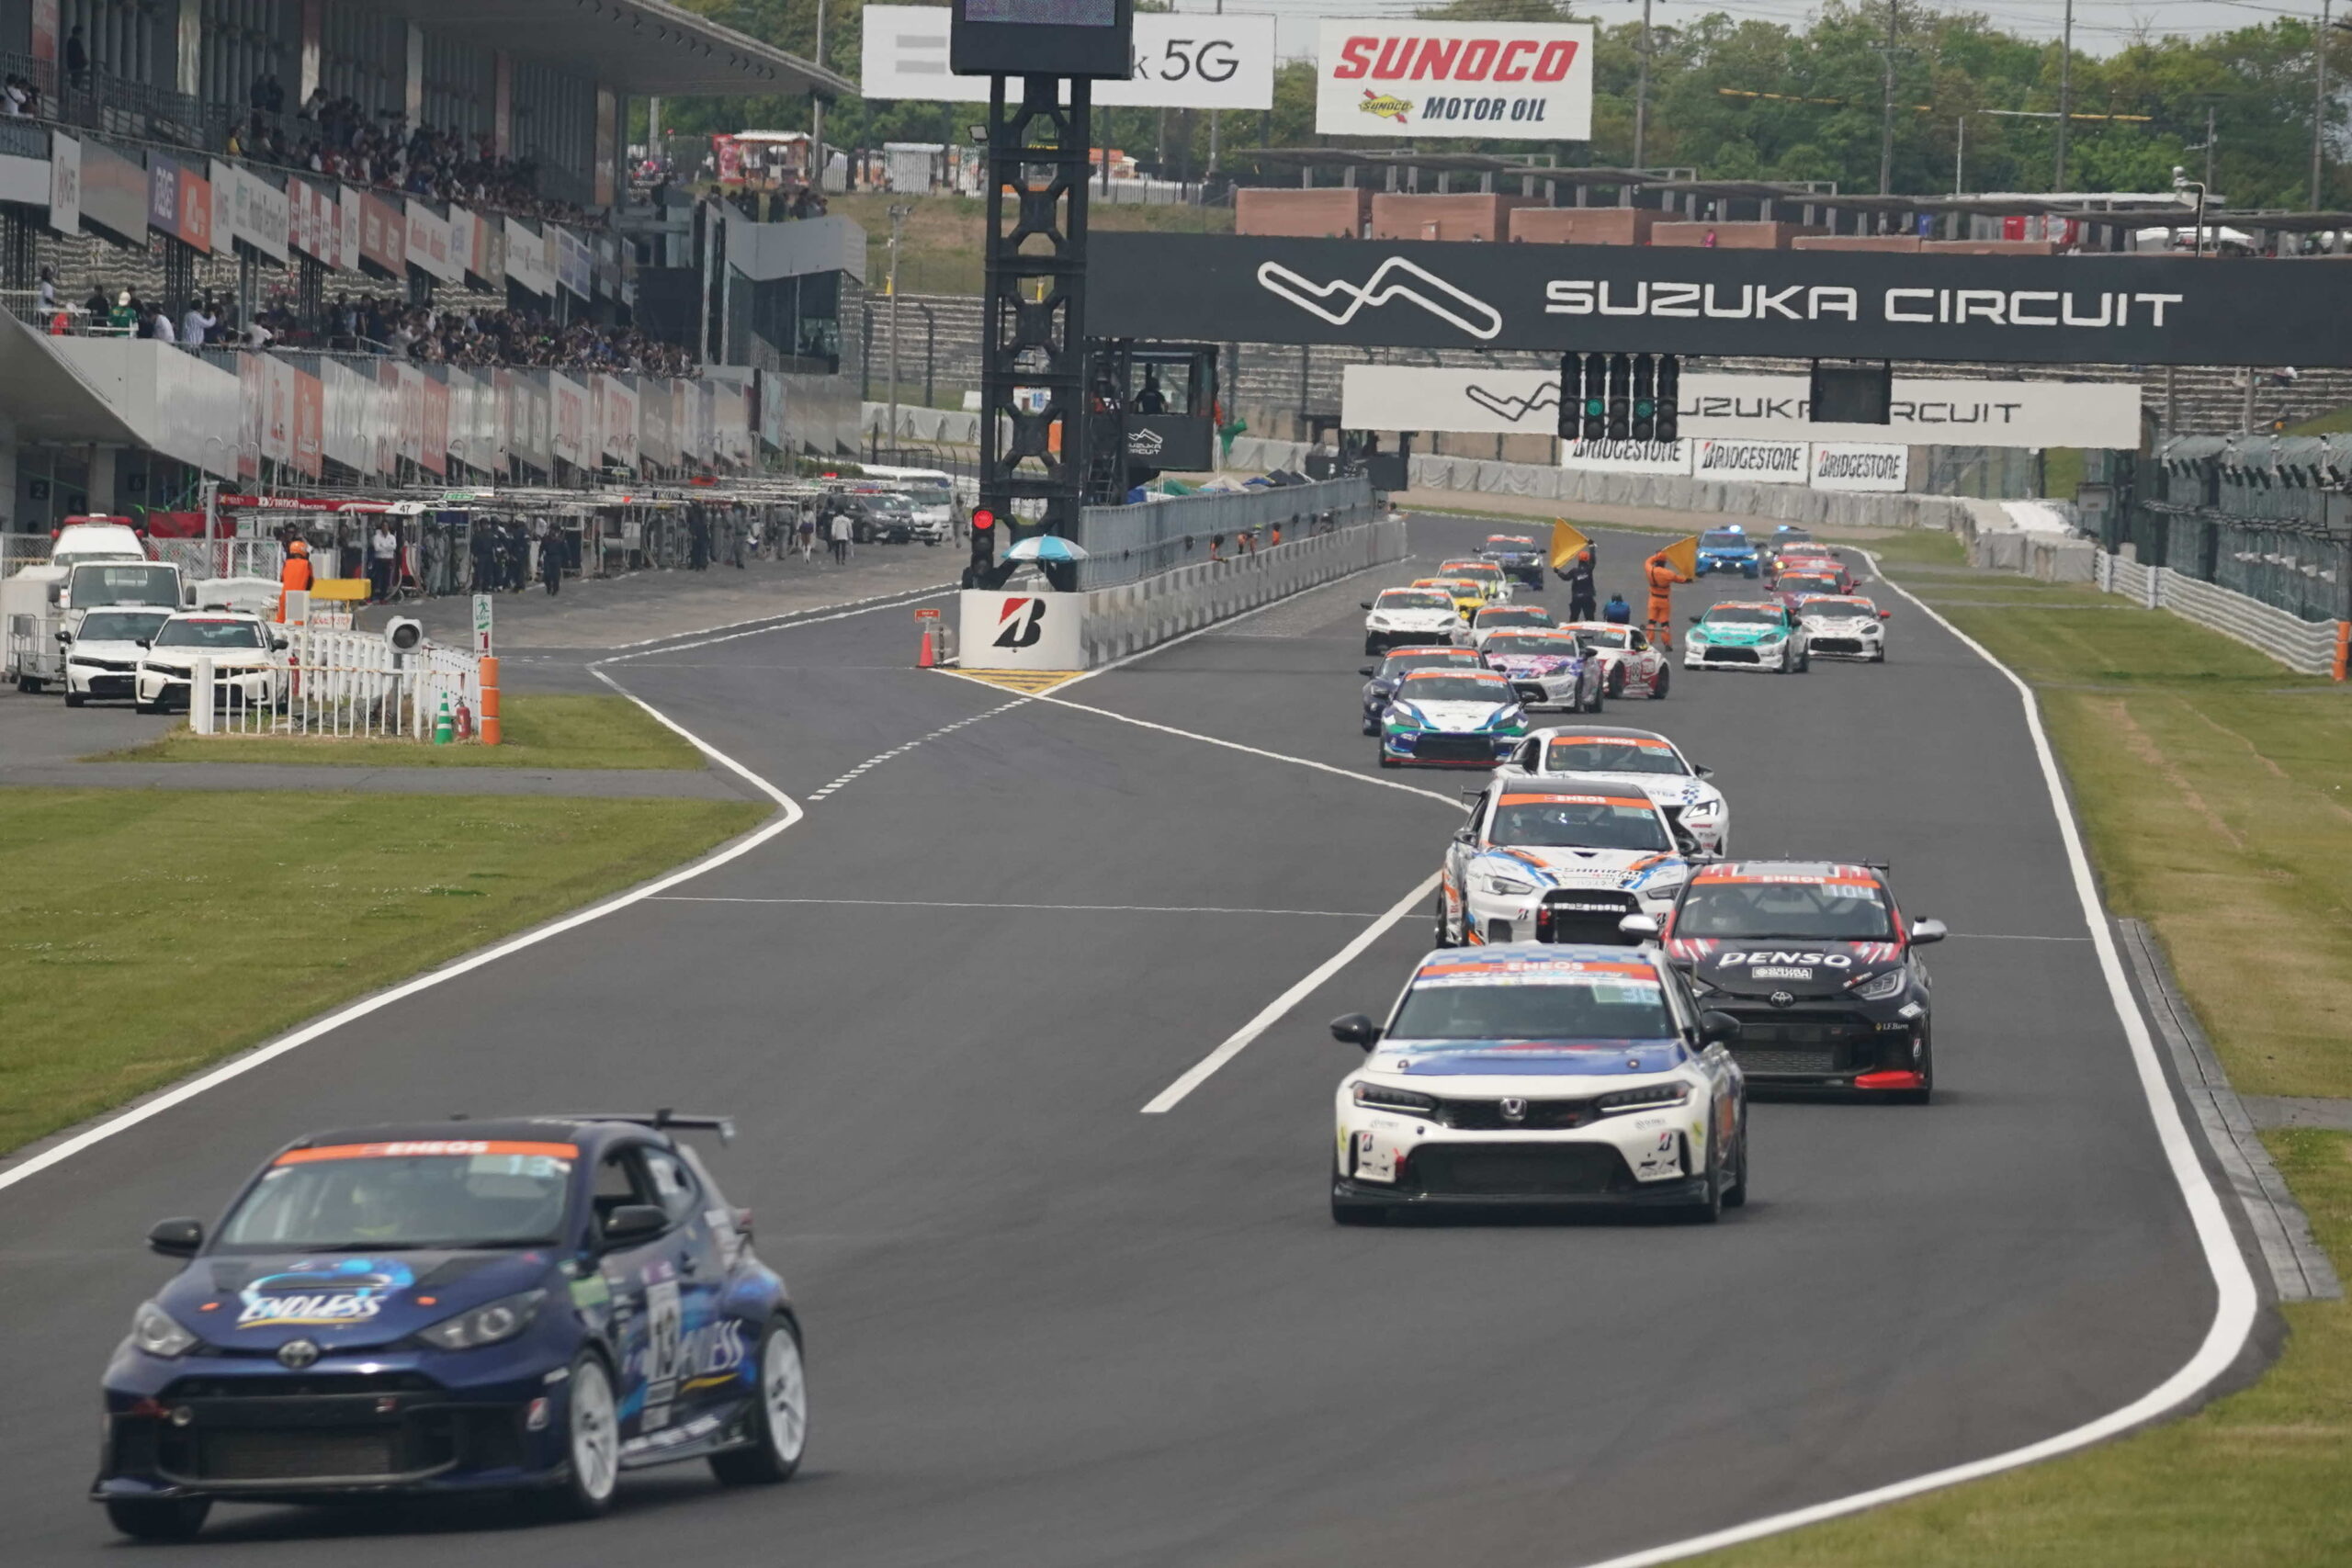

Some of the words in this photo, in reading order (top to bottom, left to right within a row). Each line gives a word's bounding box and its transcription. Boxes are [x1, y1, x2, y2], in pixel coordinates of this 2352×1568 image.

[1160, 39, 1239, 83] 5G
[1333, 36, 1579, 82] SUNOCO
[1361, 101, 1410, 112] SUNOCO
[1422, 96, 1506, 120] MOTOR
[1511, 97, 1547, 121] OIL
[1545, 280, 1857, 321] SUZUKA
[1884, 288, 2184, 326] CIRCUIT
[1678, 397, 1810, 419] UZUK
[1702, 441, 1802, 472] BRIDGESTONE
[1818, 449, 1901, 480] BRIDGESTONE
[399, 504, 411, 513] 47
[1597, 738, 1636, 746] ENEOS
[1557, 795, 1606, 804] ENEOS
[1763, 874, 1826, 884] ENEOS
[1829, 884, 1875, 900] 104
[1507, 961, 1586, 971] ENEOS
[1718, 952, 1852, 967] DENSO
[386, 1141, 490, 1156] ENEOS
[238, 1294, 388, 1323] ENDLESS
